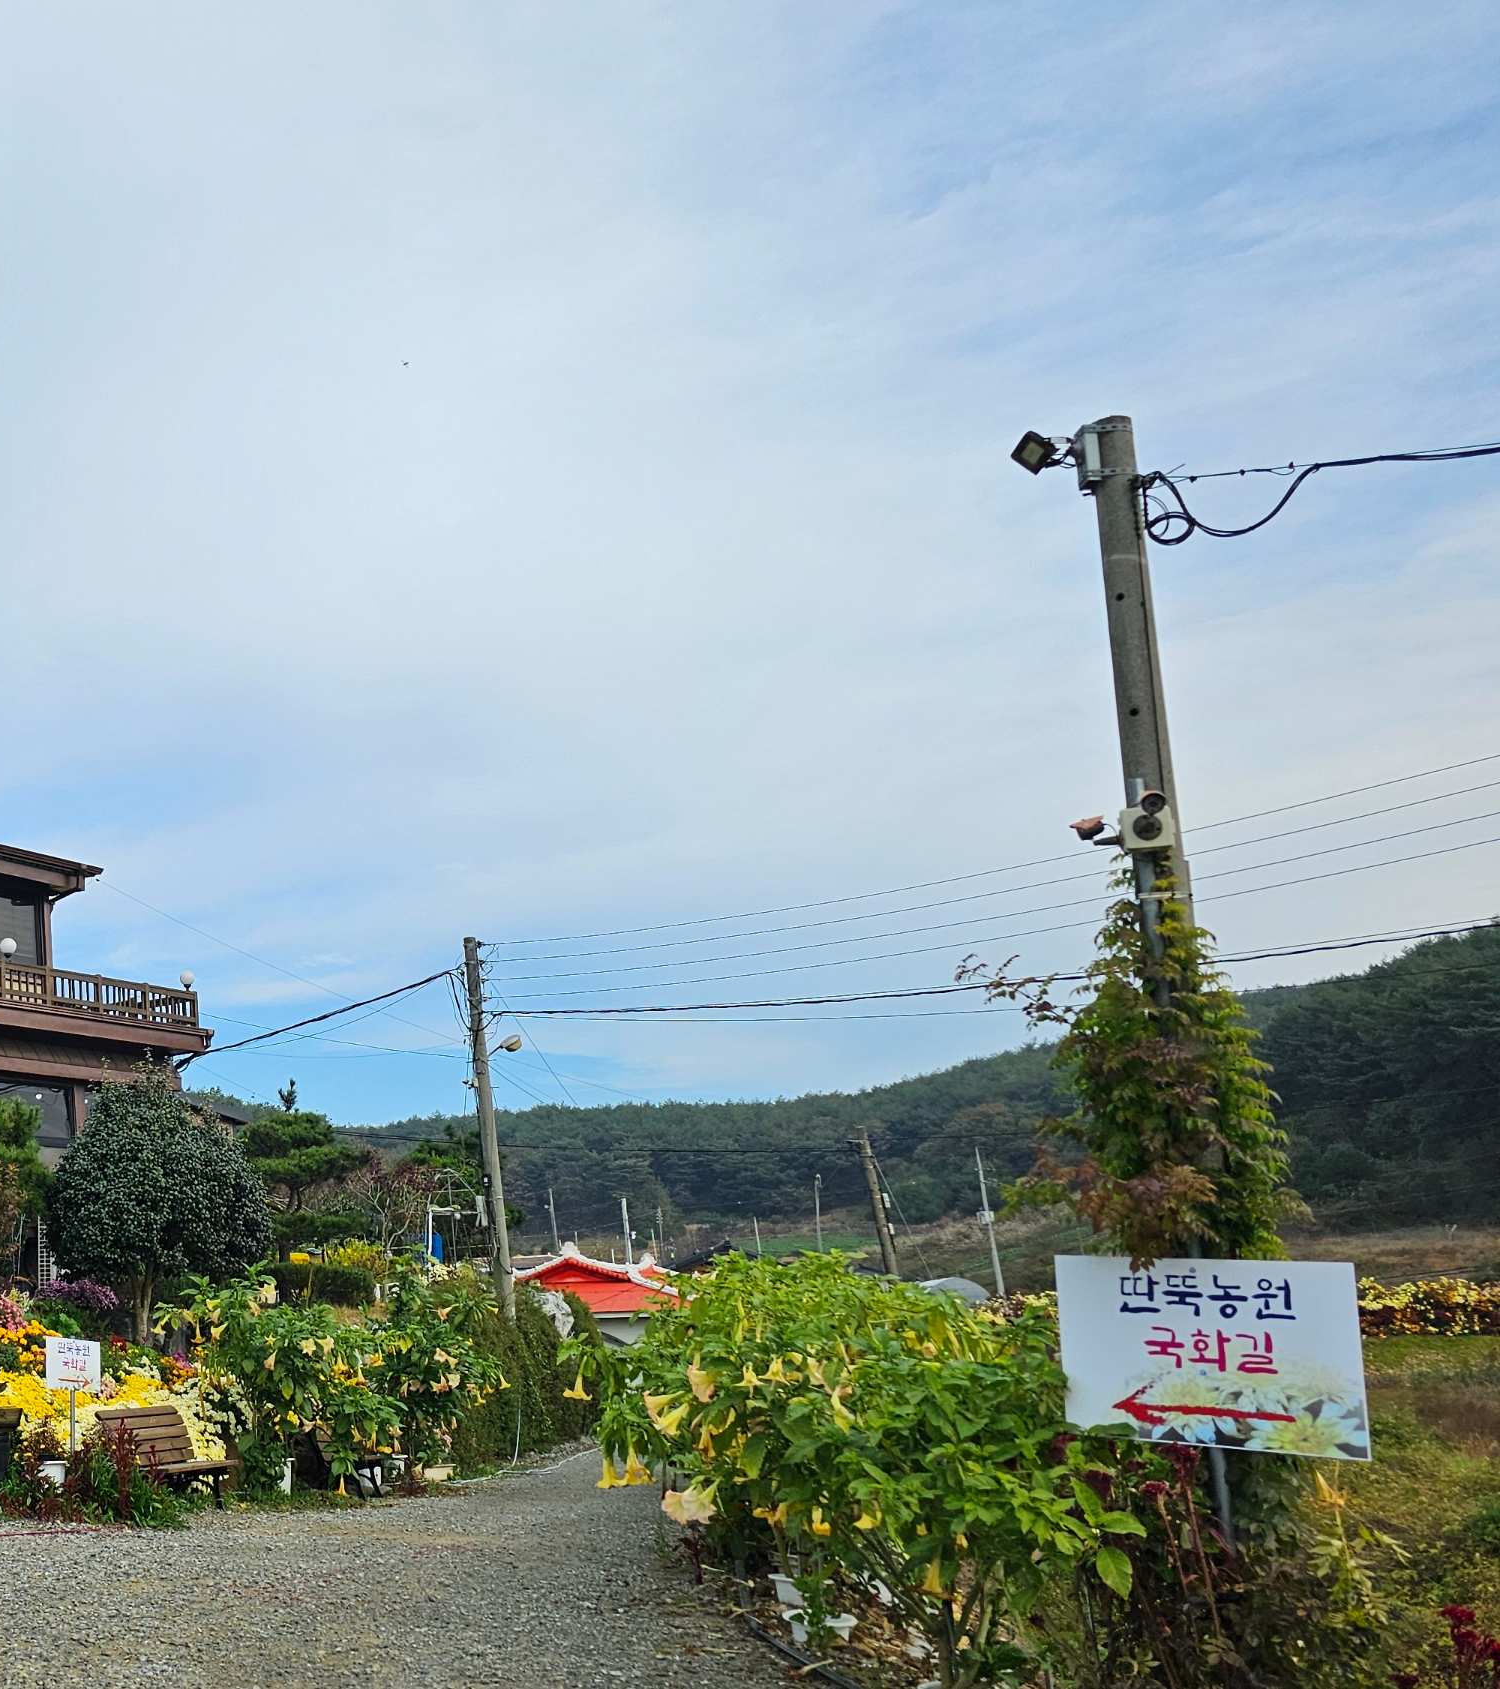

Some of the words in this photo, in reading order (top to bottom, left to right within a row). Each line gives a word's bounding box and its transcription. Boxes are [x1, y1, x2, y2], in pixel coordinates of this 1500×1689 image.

[1118, 1274, 1297, 1320] 딴뚝농원
[62, 1356, 87, 1372] 국화길
[1143, 1326, 1279, 1375] 국화길
